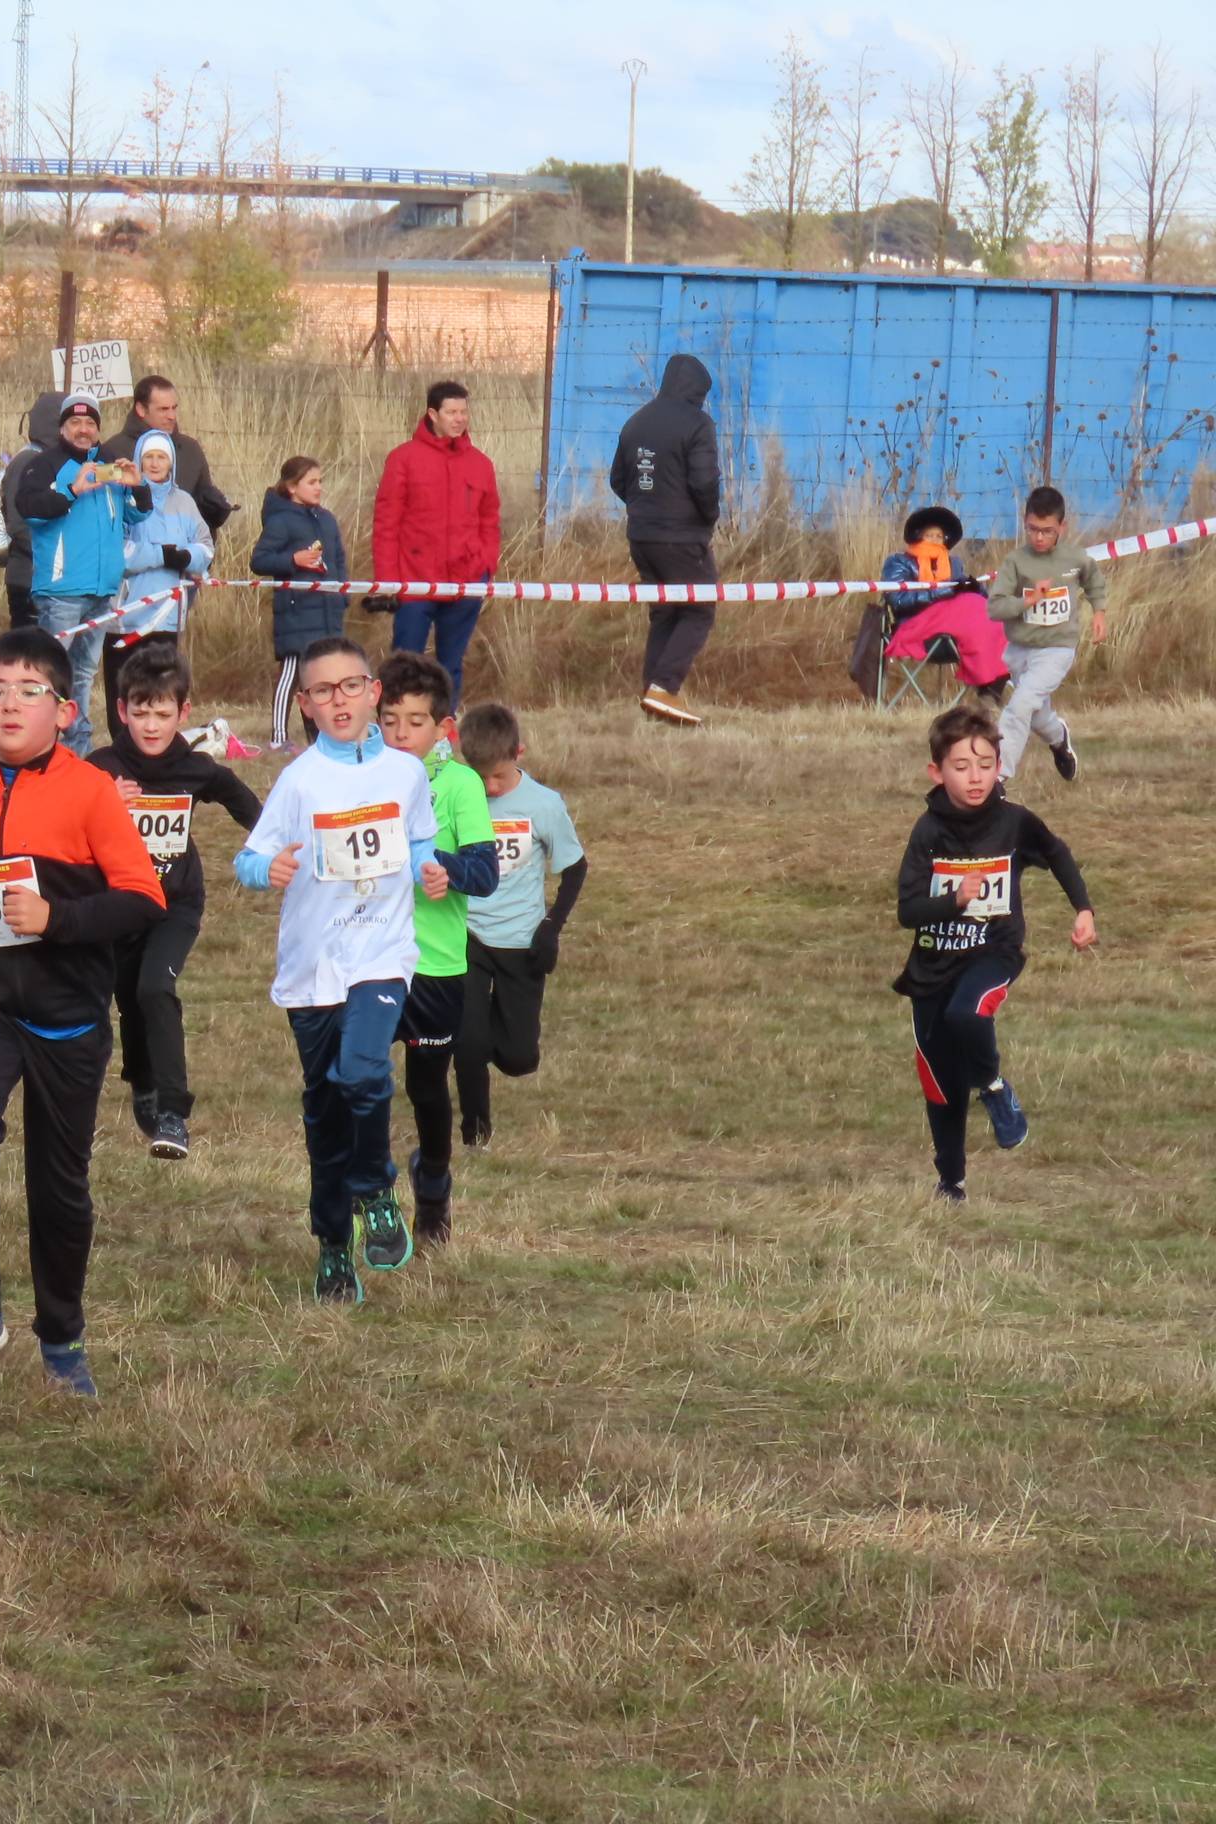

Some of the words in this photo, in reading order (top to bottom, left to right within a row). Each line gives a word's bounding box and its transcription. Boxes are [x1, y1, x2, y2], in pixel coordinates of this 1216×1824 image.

[83, 364, 104, 382] DE
[130, 813, 185, 837] 004
[345, 828, 381, 860] 19
[941, 876, 1003, 901] 101
